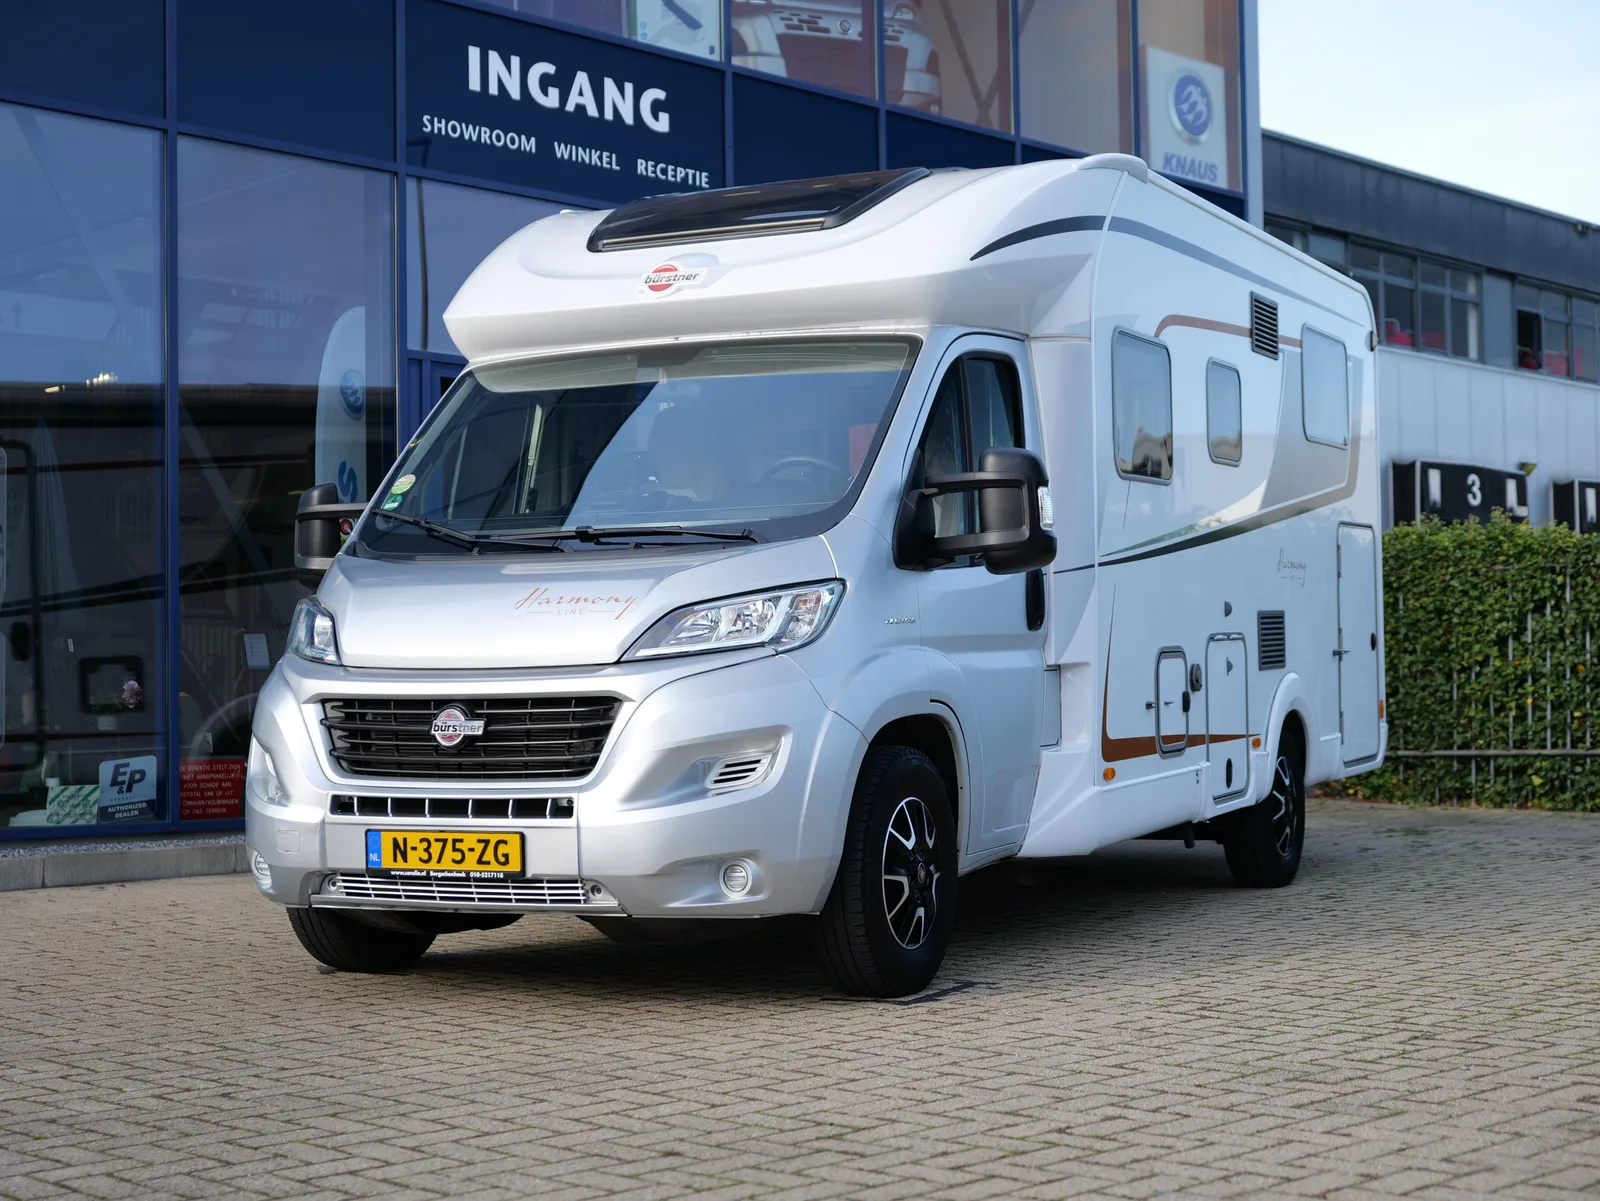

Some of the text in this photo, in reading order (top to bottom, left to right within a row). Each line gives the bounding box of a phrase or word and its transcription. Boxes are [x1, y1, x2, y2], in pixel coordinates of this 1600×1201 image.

[467, 45, 671, 133] INGANG
[422, 114, 710, 189] SHOWROOM WINKEL RECEPTIE
[1163, 151, 1219, 183] KNAUS
[644, 272, 700, 284] bürstner
[1466, 473, 1482, 507] 3
[515, 587, 638, 620] Harmony
[557, 608, 585, 616] LINE
[107, 802, 147, 813] AUTHORIZED
[114, 810, 139, 819] DEALER
[369, 836, 510, 867] NL N-375-ZG
